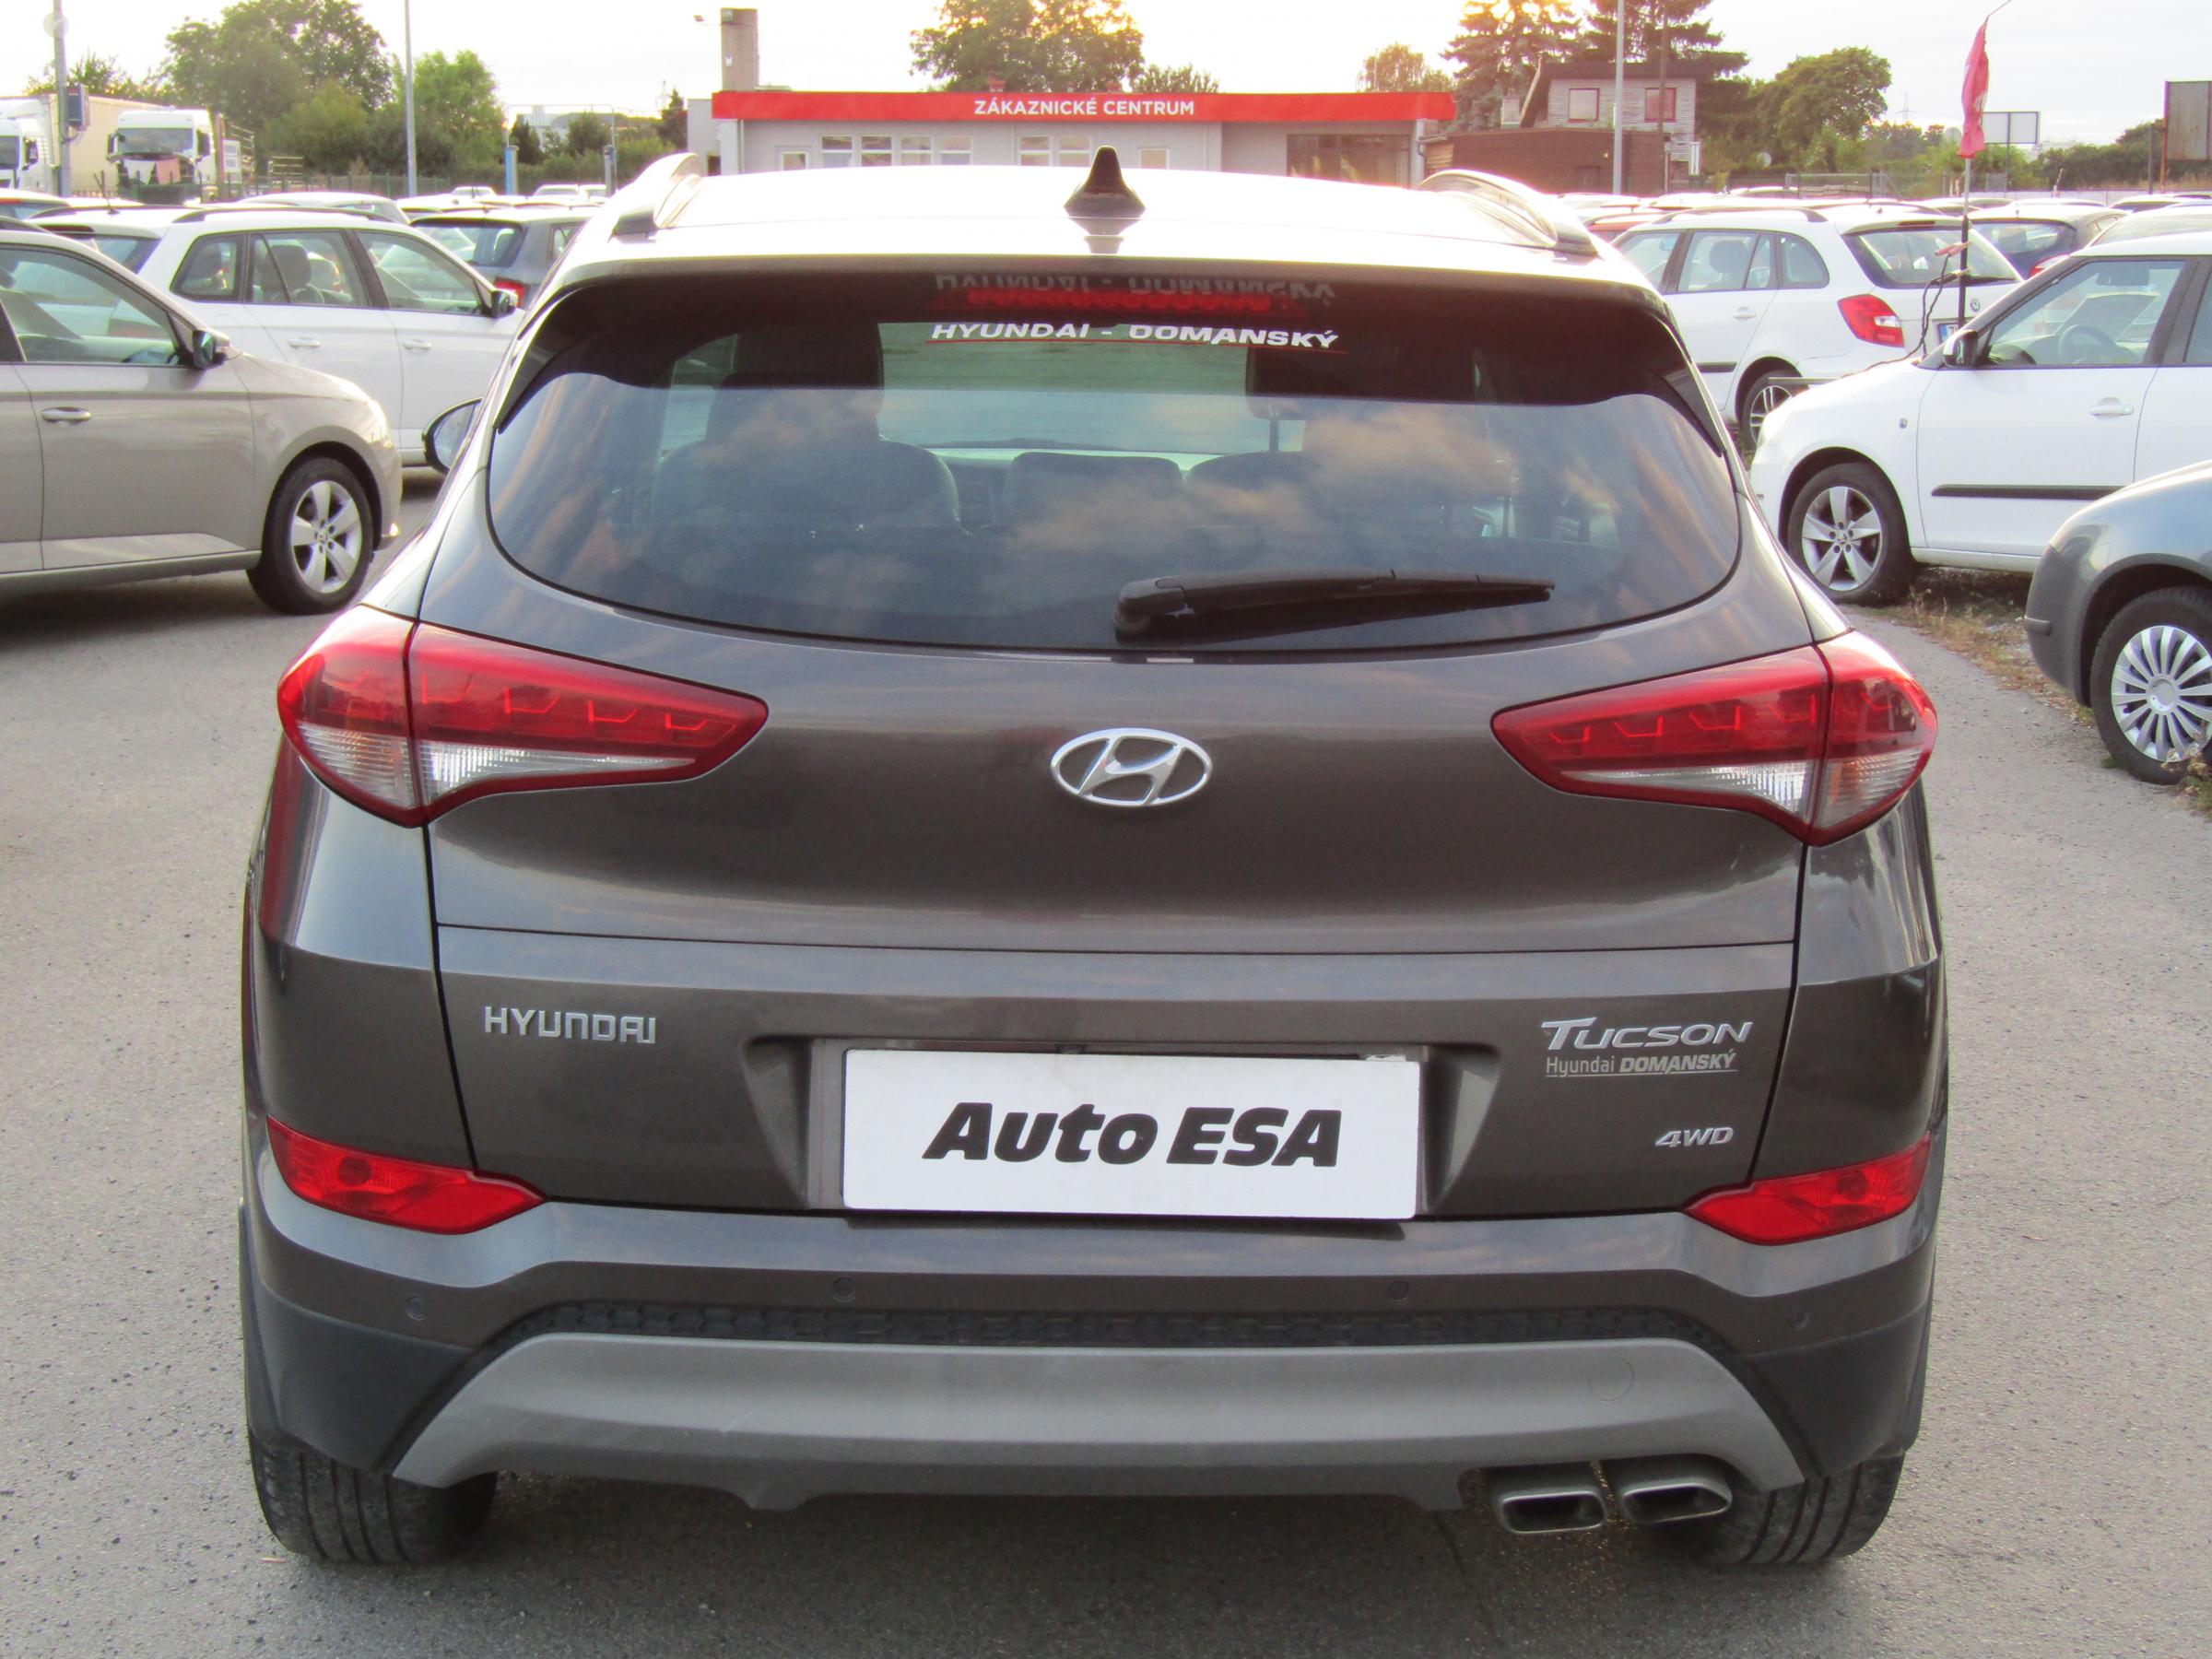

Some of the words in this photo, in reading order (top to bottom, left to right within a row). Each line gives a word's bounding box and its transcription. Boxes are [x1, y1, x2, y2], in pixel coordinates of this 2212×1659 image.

[973, 97, 1098, 115] ZÁKAZNICKÉ
[1103, 100, 1194, 115] CENTRUM
[931, 324, 1090, 339] HYUNDAI
[1128, 324, 1338, 348] DOMANSKÝ
[485, 1006, 656, 1044] HYUNDAI
[1541, 1017, 1753, 1051] TUCSON
[1546, 1055, 1615, 1077] Hyundai
[1618, 1049, 1737, 1075] DOMANSKÝ
[922, 1102, 1159, 1165] Auto
[1165, 1106, 1342, 1167] ESA
[1655, 1126, 1734, 1147] 4WD
